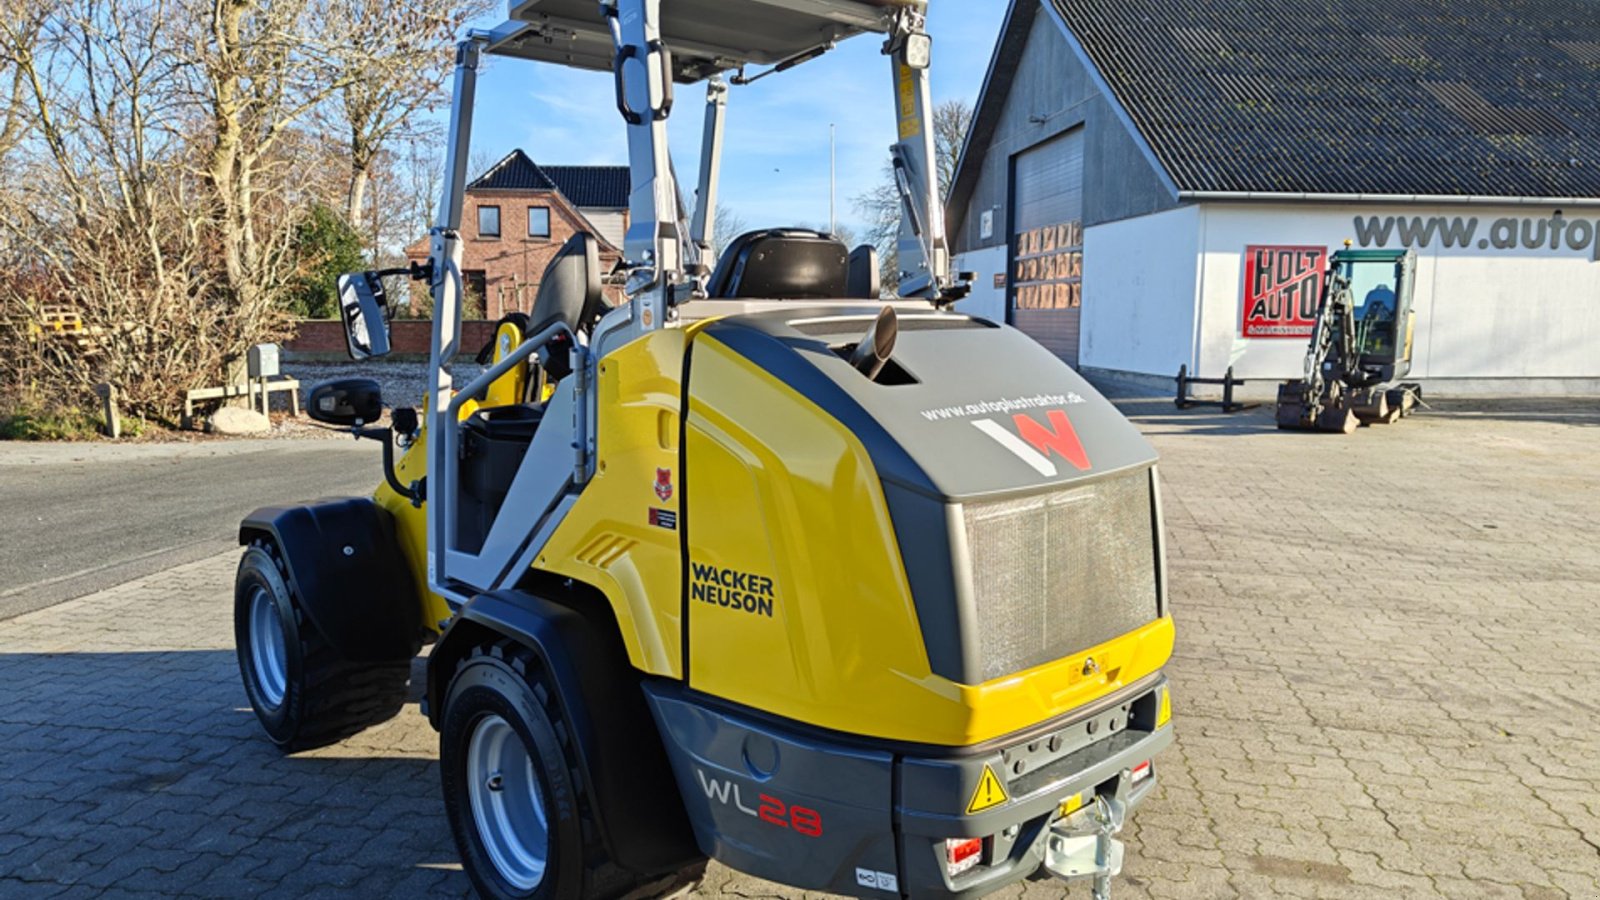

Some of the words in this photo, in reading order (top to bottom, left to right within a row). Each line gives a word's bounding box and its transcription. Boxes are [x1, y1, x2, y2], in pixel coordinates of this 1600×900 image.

[1353, 210, 1600, 261] www.auto
[1248, 272, 1319, 319] AUTO
[1254, 249, 1321, 297] HOLT
[692, 562, 774, 597] WACKER
[692, 582, 773, 617] NEUSON
[698, 769, 823, 837] WL28
